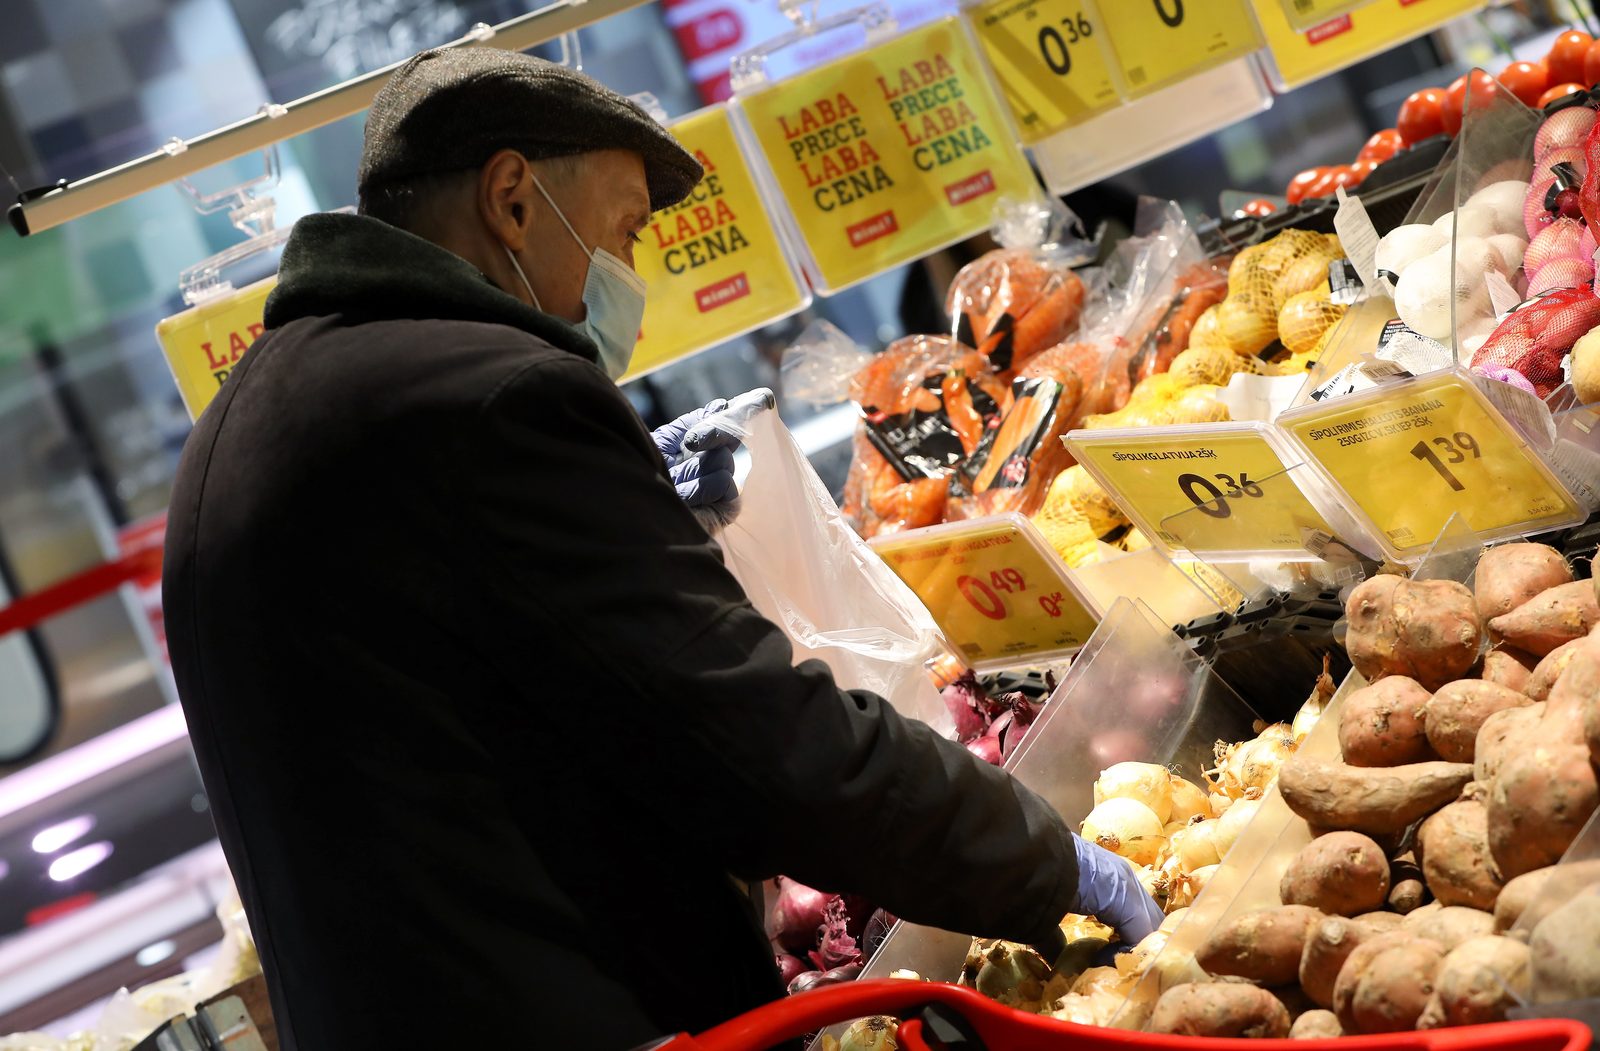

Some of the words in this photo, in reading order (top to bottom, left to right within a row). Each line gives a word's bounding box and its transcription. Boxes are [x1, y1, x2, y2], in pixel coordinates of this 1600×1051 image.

[876, 53, 955, 100] LABA
[889, 77, 965, 121] PRECE
[777, 92, 858, 140] LABA
[790, 116, 867, 162] PRECE
[899, 100, 978, 147] LABA
[799, 138, 881, 188] LABA
[913, 124, 992, 172] CENA
[814, 165, 895, 212] CENA
[651, 198, 737, 249] LABA
[664, 225, 750, 276] CENA
[1336, 421, 1358, 435] RIMI
[1401, 400, 1444, 417] BANANA
[1155, 450, 1198, 460] LATVIJA
